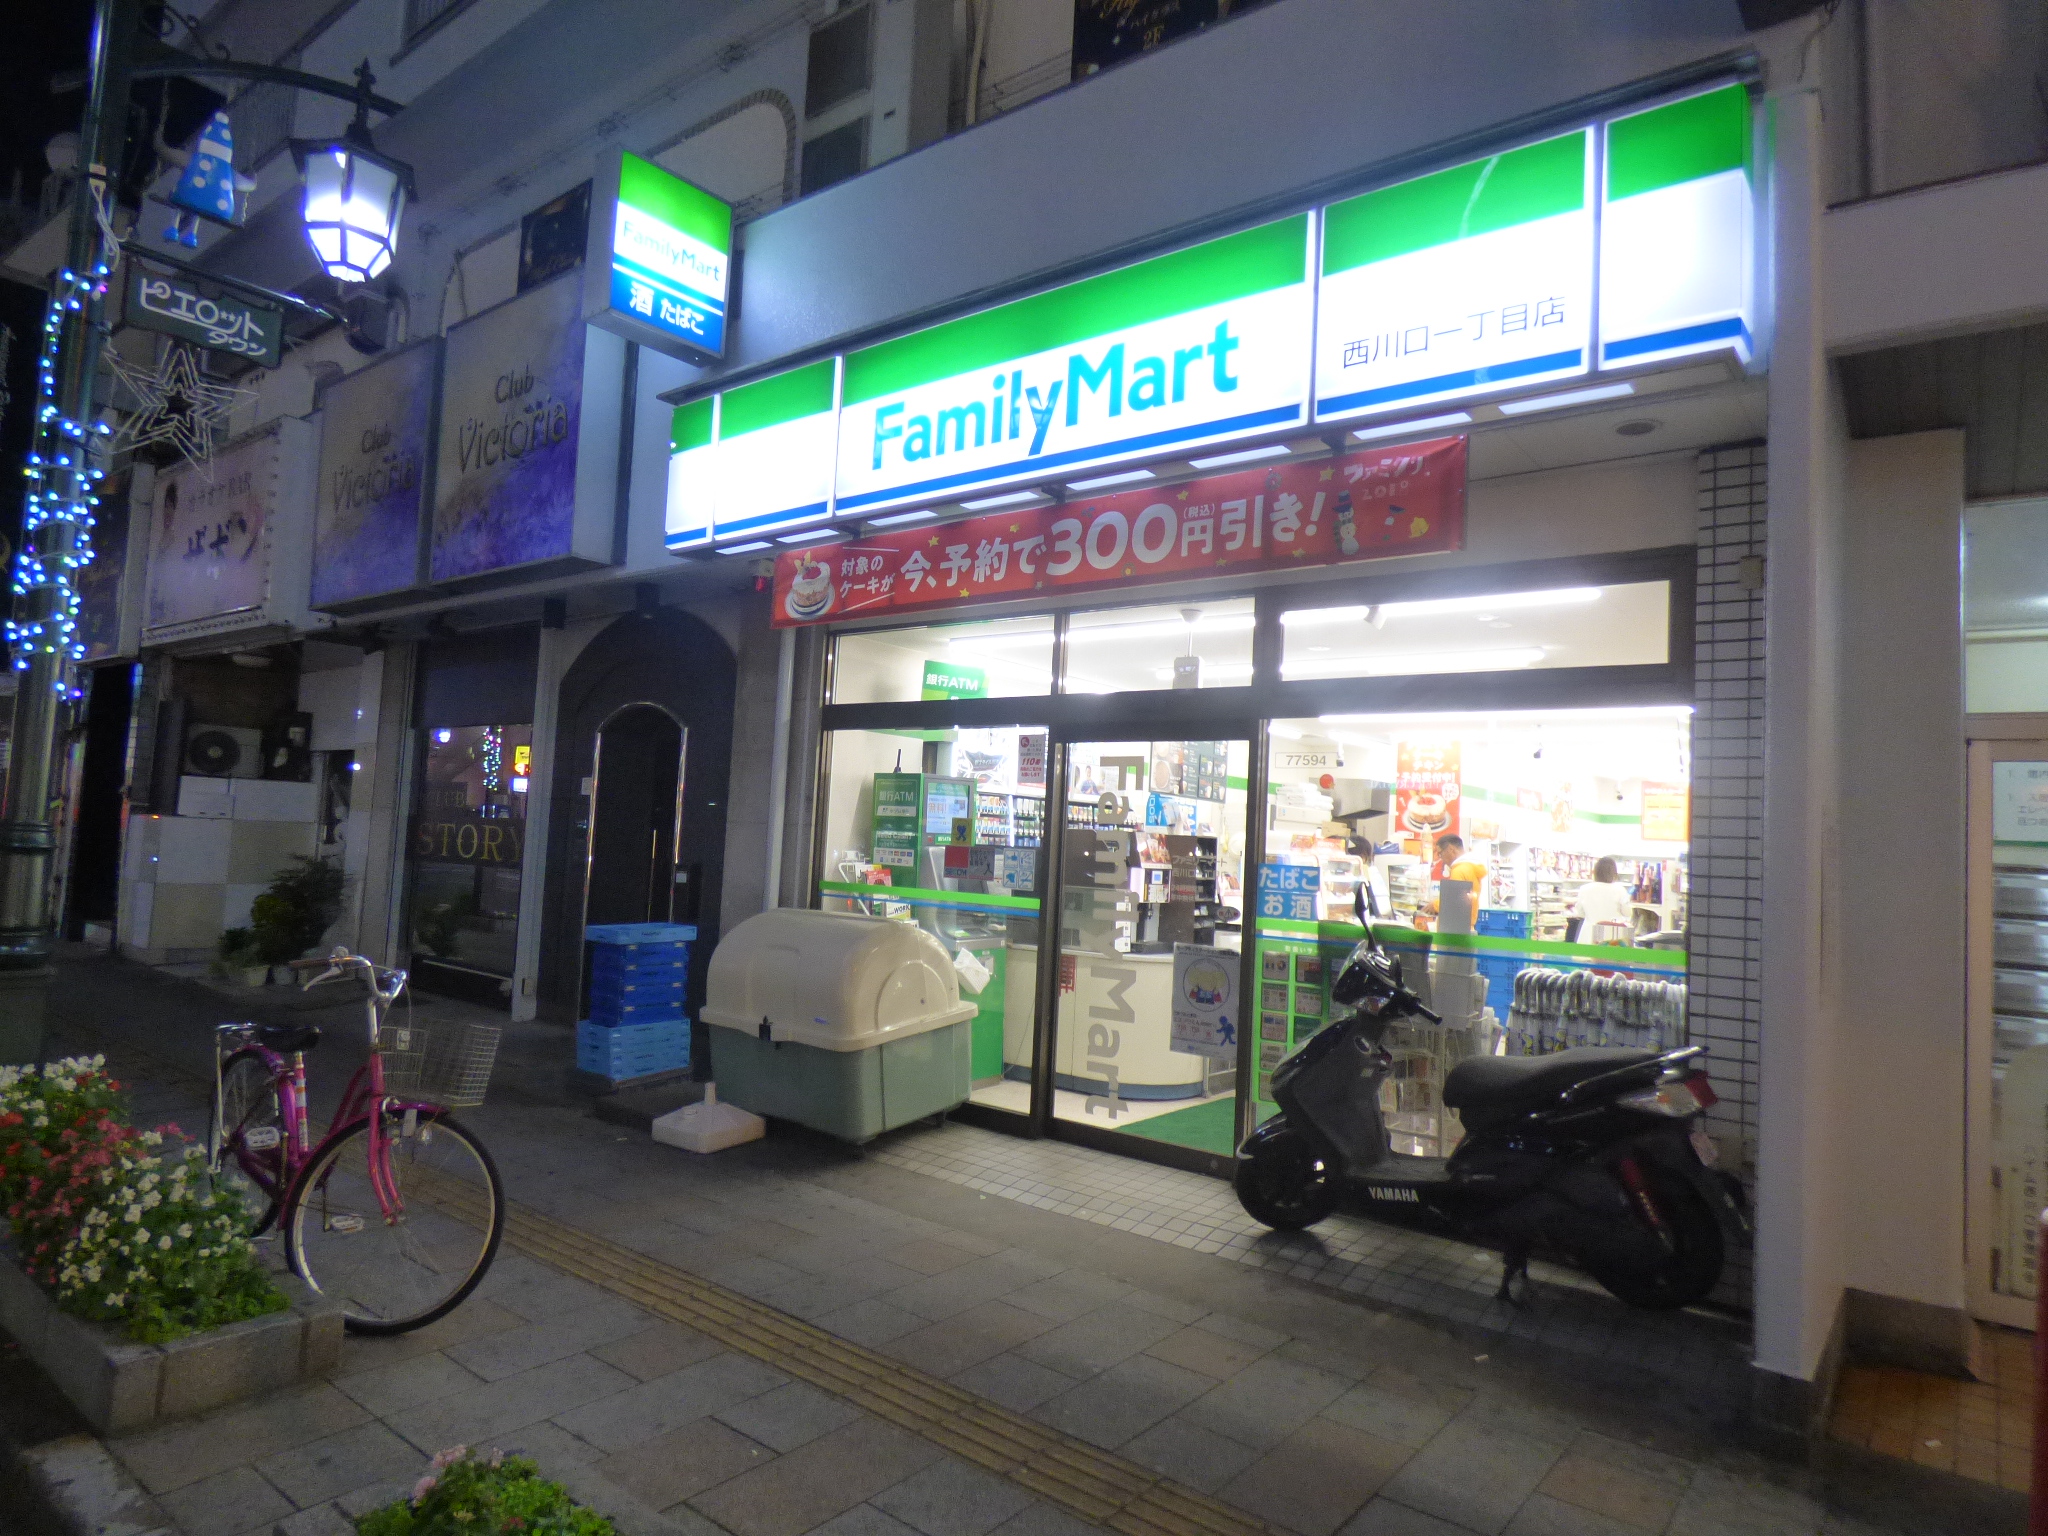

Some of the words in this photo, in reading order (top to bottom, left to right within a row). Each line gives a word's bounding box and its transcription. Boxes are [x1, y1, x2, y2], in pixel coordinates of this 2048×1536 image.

[622, 220, 720, 282] FamilyMart
[630, 281, 655, 317] 酒
[660, 298, 704, 336] たばこ
[1343, 296, 1566, 369] 西川口一丁目店
[495, 364, 534, 403] Club
[871, 318, 1240, 470] FamilyMart
[458, 397, 569, 474] Victoria
[840, 573, 896, 598] ケーキが
[841, 555, 884, 577] 対象の
[925, 673, 979, 692] 銀行ATM
[1286, 754, 1327, 767] 77594
[416, 821, 523, 861] STORY
[1259, 867, 1319, 890] たばこ
[1264, 895, 1312, 919] お酒
[1085, 755, 1145, 1121] FamilyMart
[1368, 1186, 1420, 1203] YAMAHA
